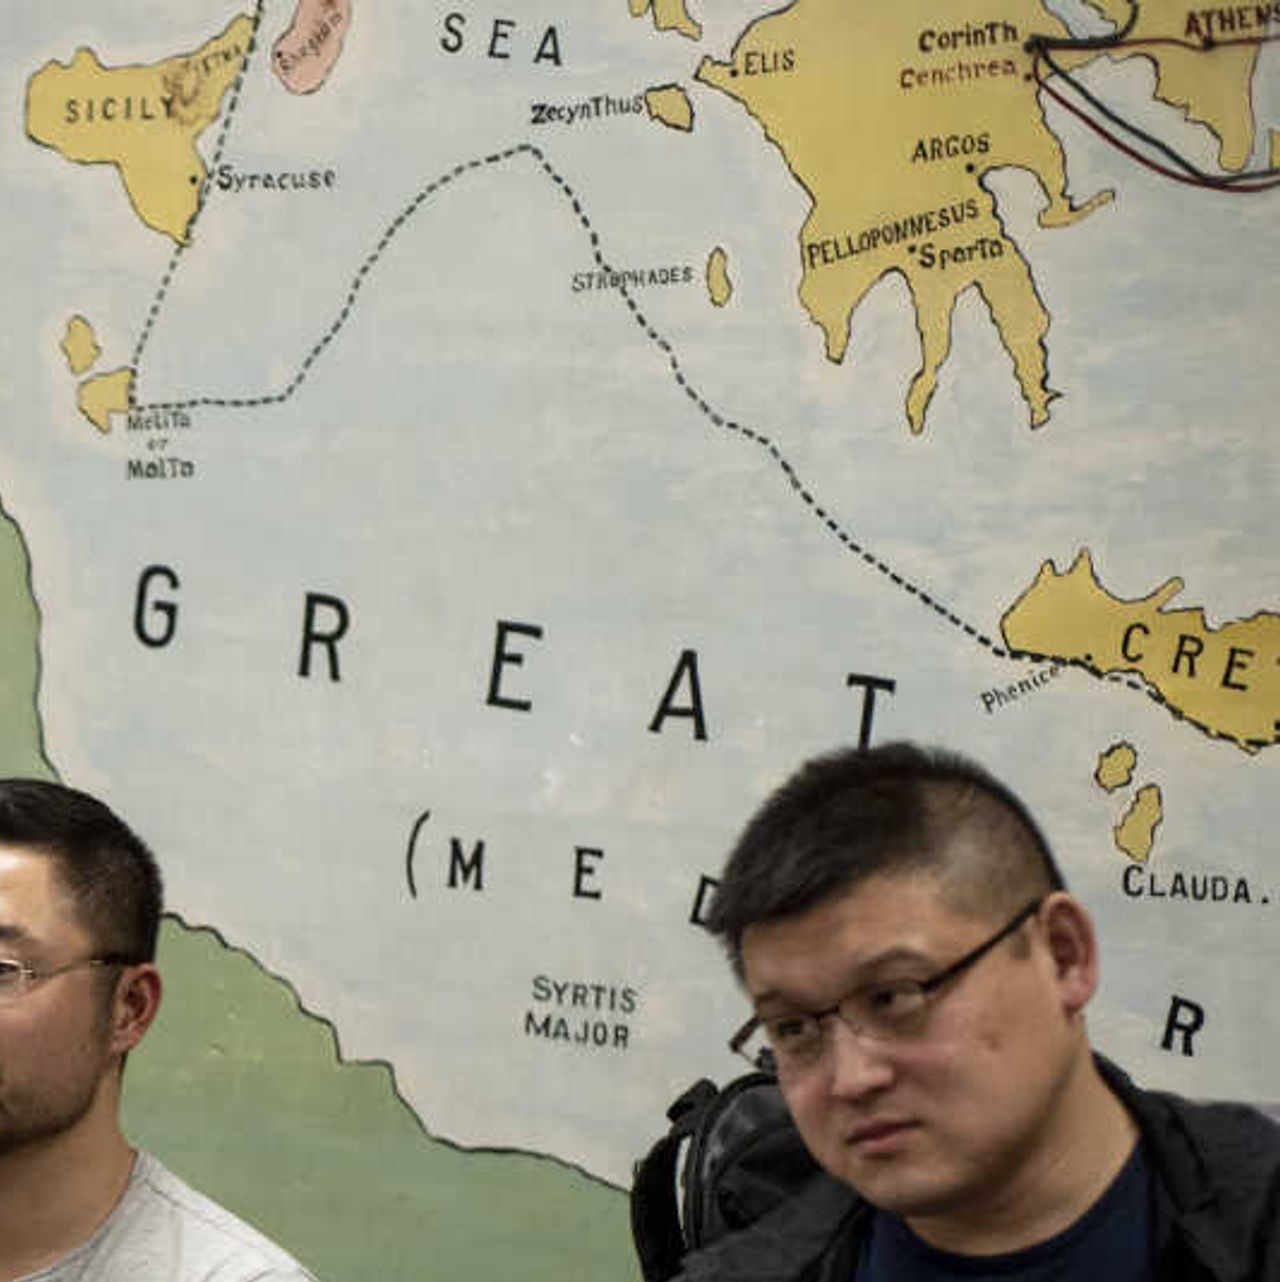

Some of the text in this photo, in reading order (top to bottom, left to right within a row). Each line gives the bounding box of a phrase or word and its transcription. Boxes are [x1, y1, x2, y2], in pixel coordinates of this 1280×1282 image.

[440, 12, 563, 66] SEA
[744, 50, 795, 76] ELIS
[65, 95, 175, 125] SICILY
[912, 133, 991, 164] ARGOS
[217, 166, 337, 194] Syracuse
[133, 565, 897, 749] GREAT
[1121, 623, 1280, 691] CRE
[531, 975, 638, 1014] SYRTIS
[525, 1010, 630, 1050] MAJOR
